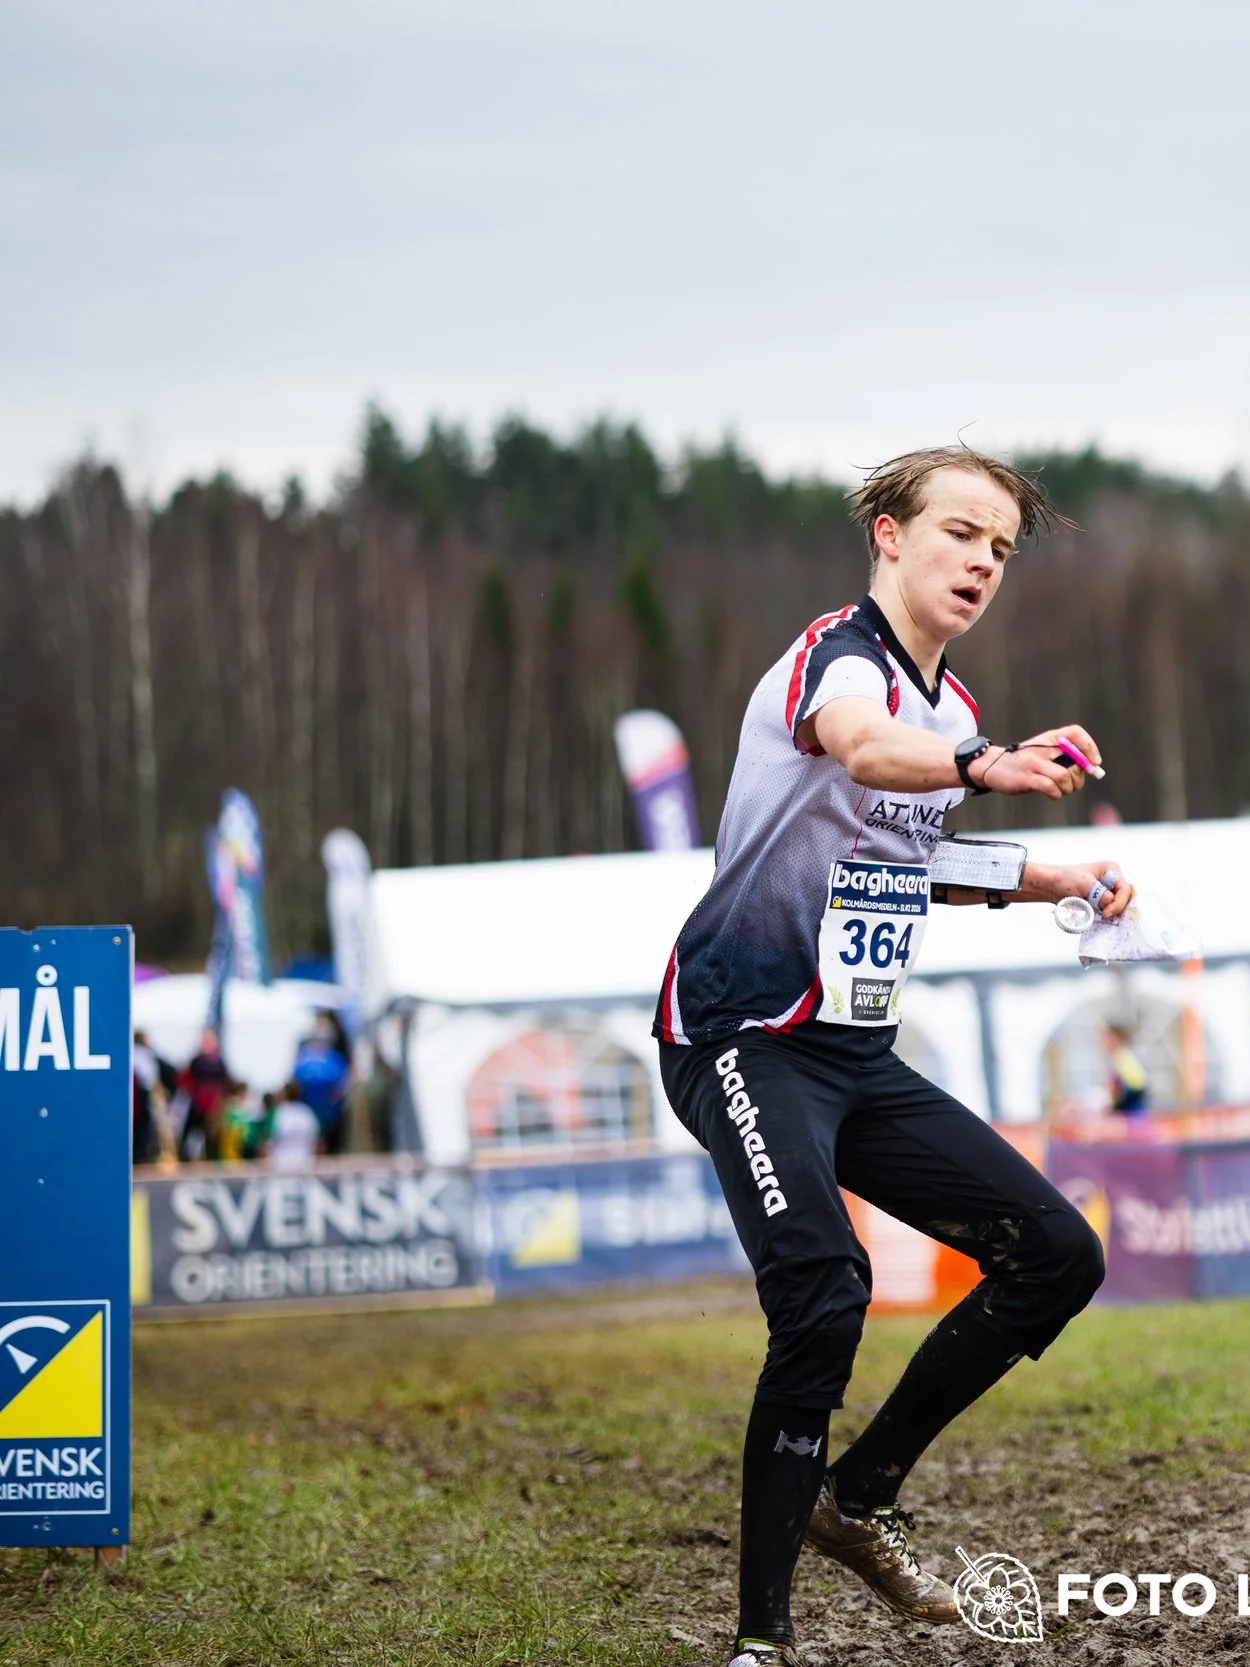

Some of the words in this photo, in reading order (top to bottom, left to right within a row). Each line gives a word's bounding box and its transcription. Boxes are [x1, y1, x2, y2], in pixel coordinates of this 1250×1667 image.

[833, 864, 928, 896] bagheera
[839, 918, 914, 968] 364
[715, 1048, 788, 1218] bagheera
[170, 1172, 452, 1254] SVENSK
[170, 1239, 459, 1303] ORIENTERING
[0, 1447, 104, 1477] VENSK
[0, 1481, 105, 1500] IENTERING
